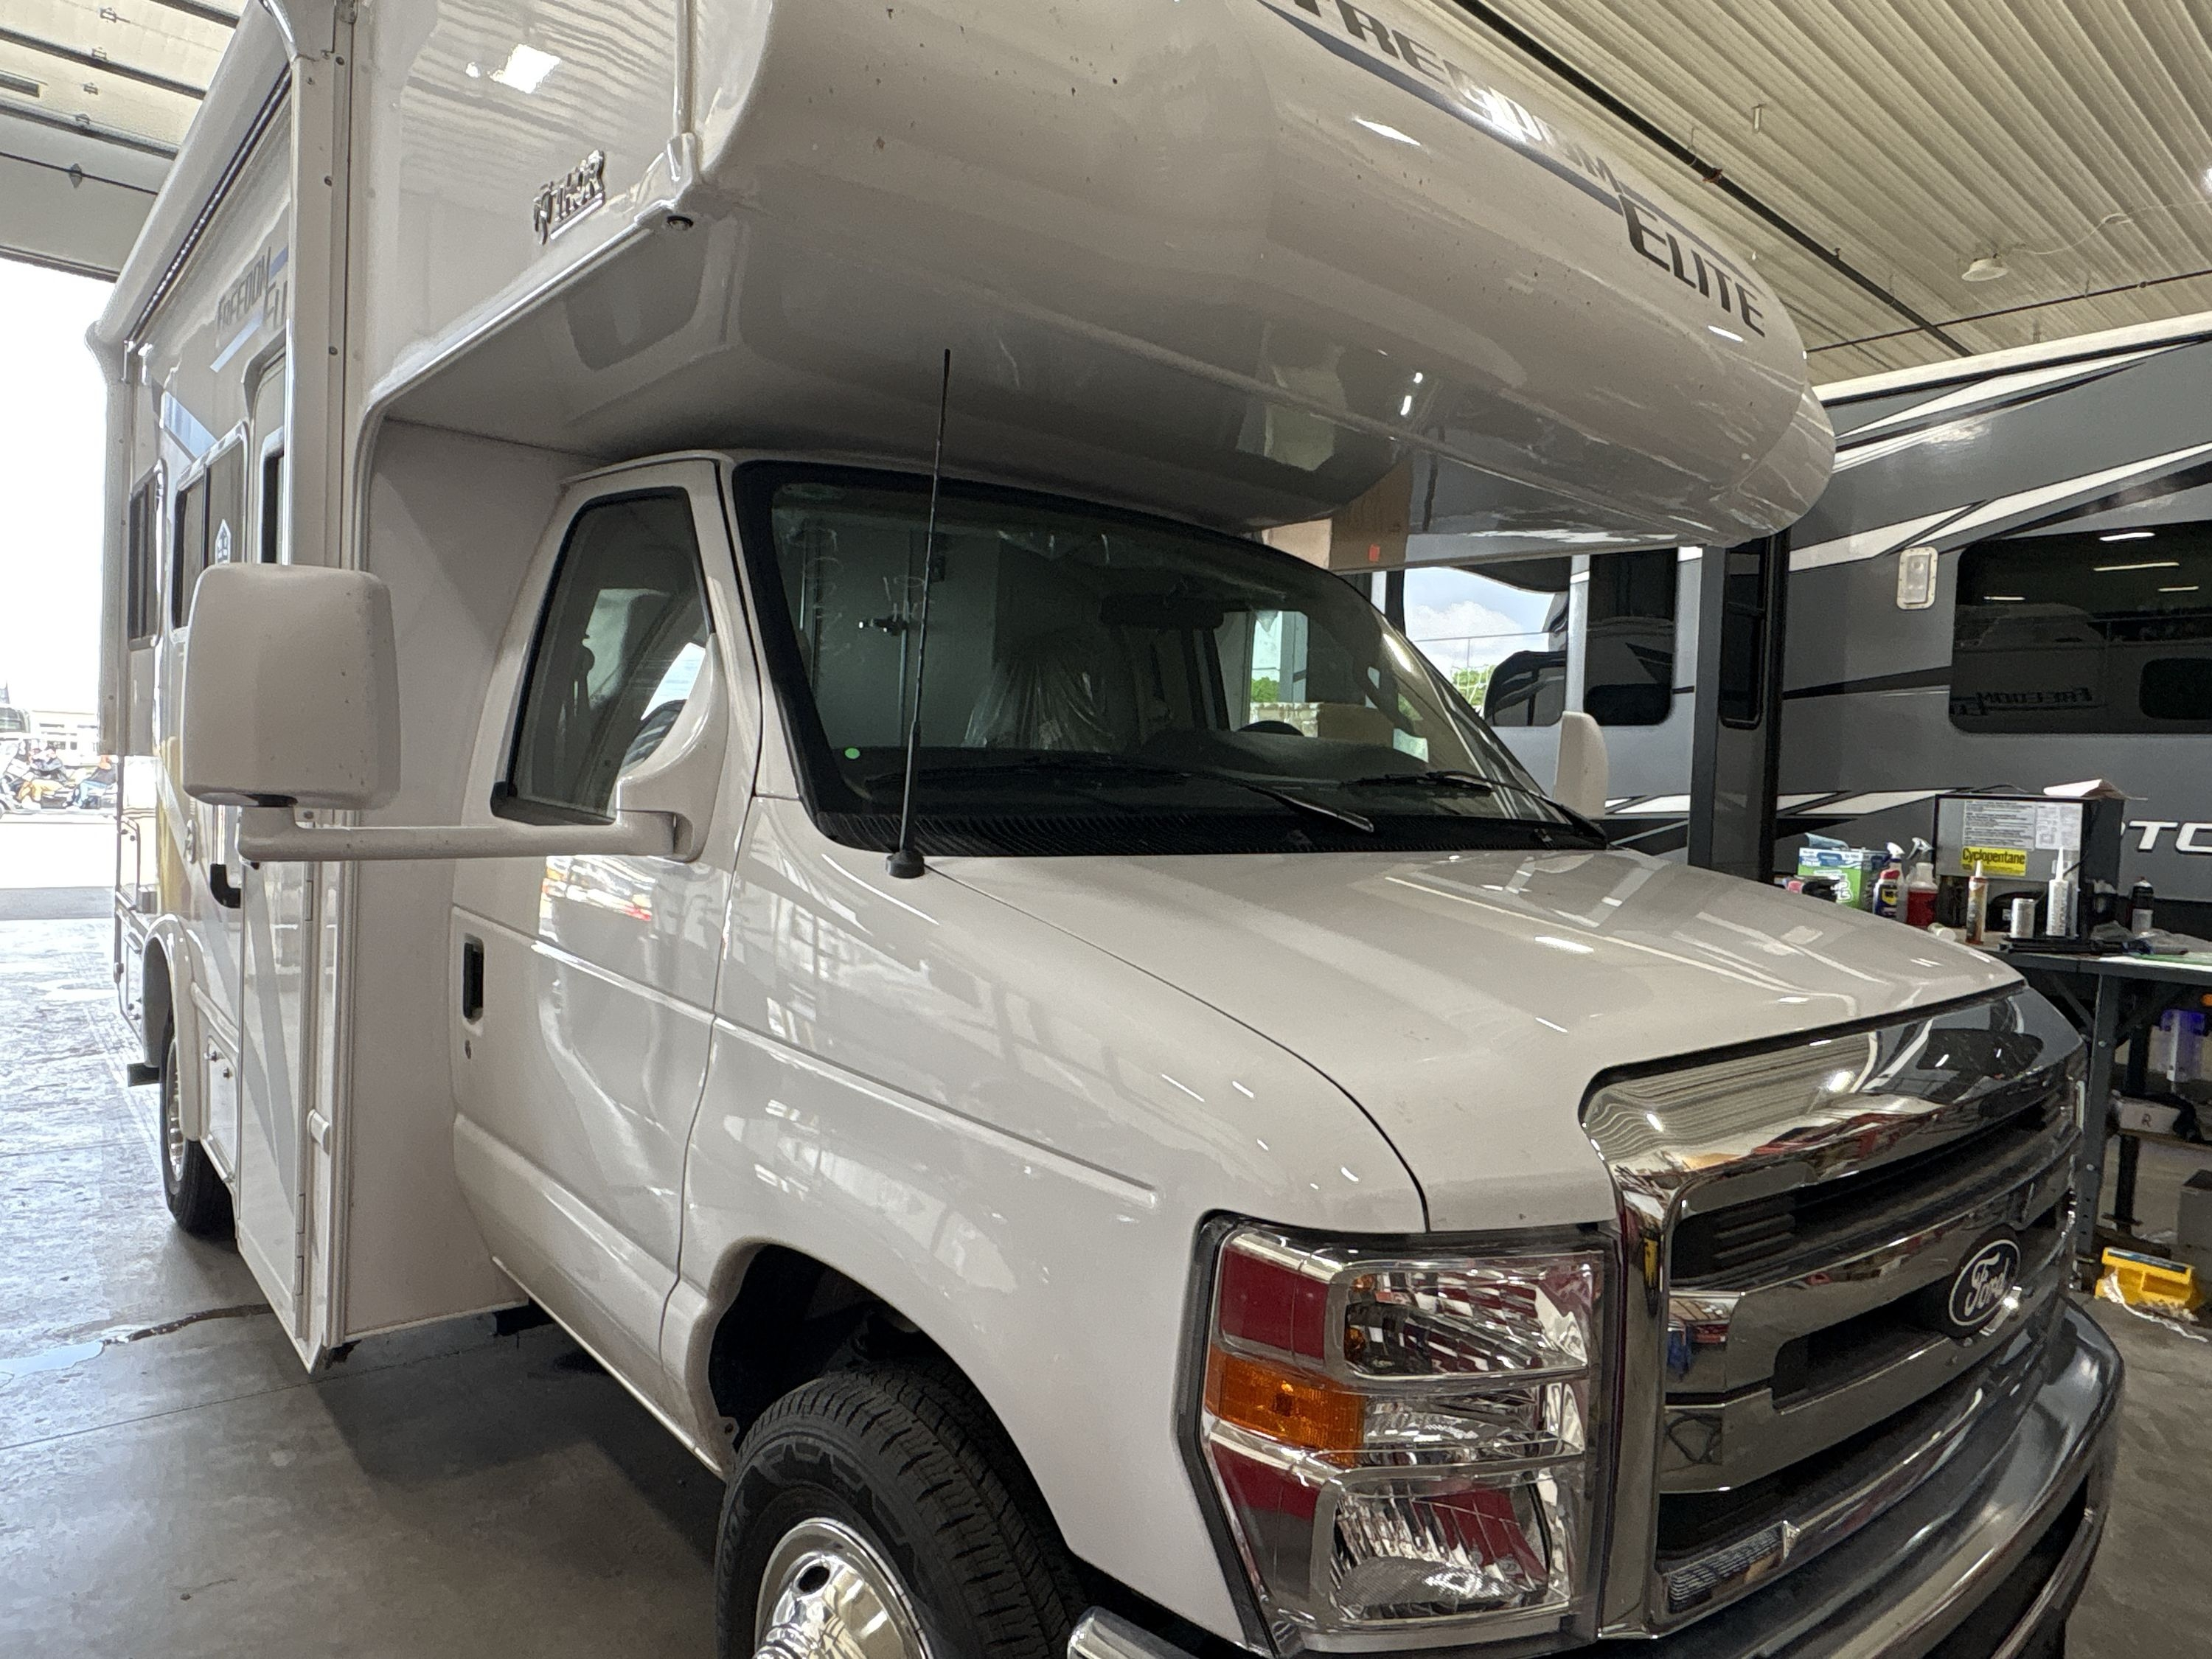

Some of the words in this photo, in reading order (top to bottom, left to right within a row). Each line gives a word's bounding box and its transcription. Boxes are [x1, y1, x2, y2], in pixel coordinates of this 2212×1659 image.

[1618, 194, 1766, 338] ELITE
[262, 280, 288, 330] ELI
[1962, 847, 2026, 865] Cyclopentane
[2120, 819, 2212, 854] TO
[1964, 1251, 2011, 1317] Ford
